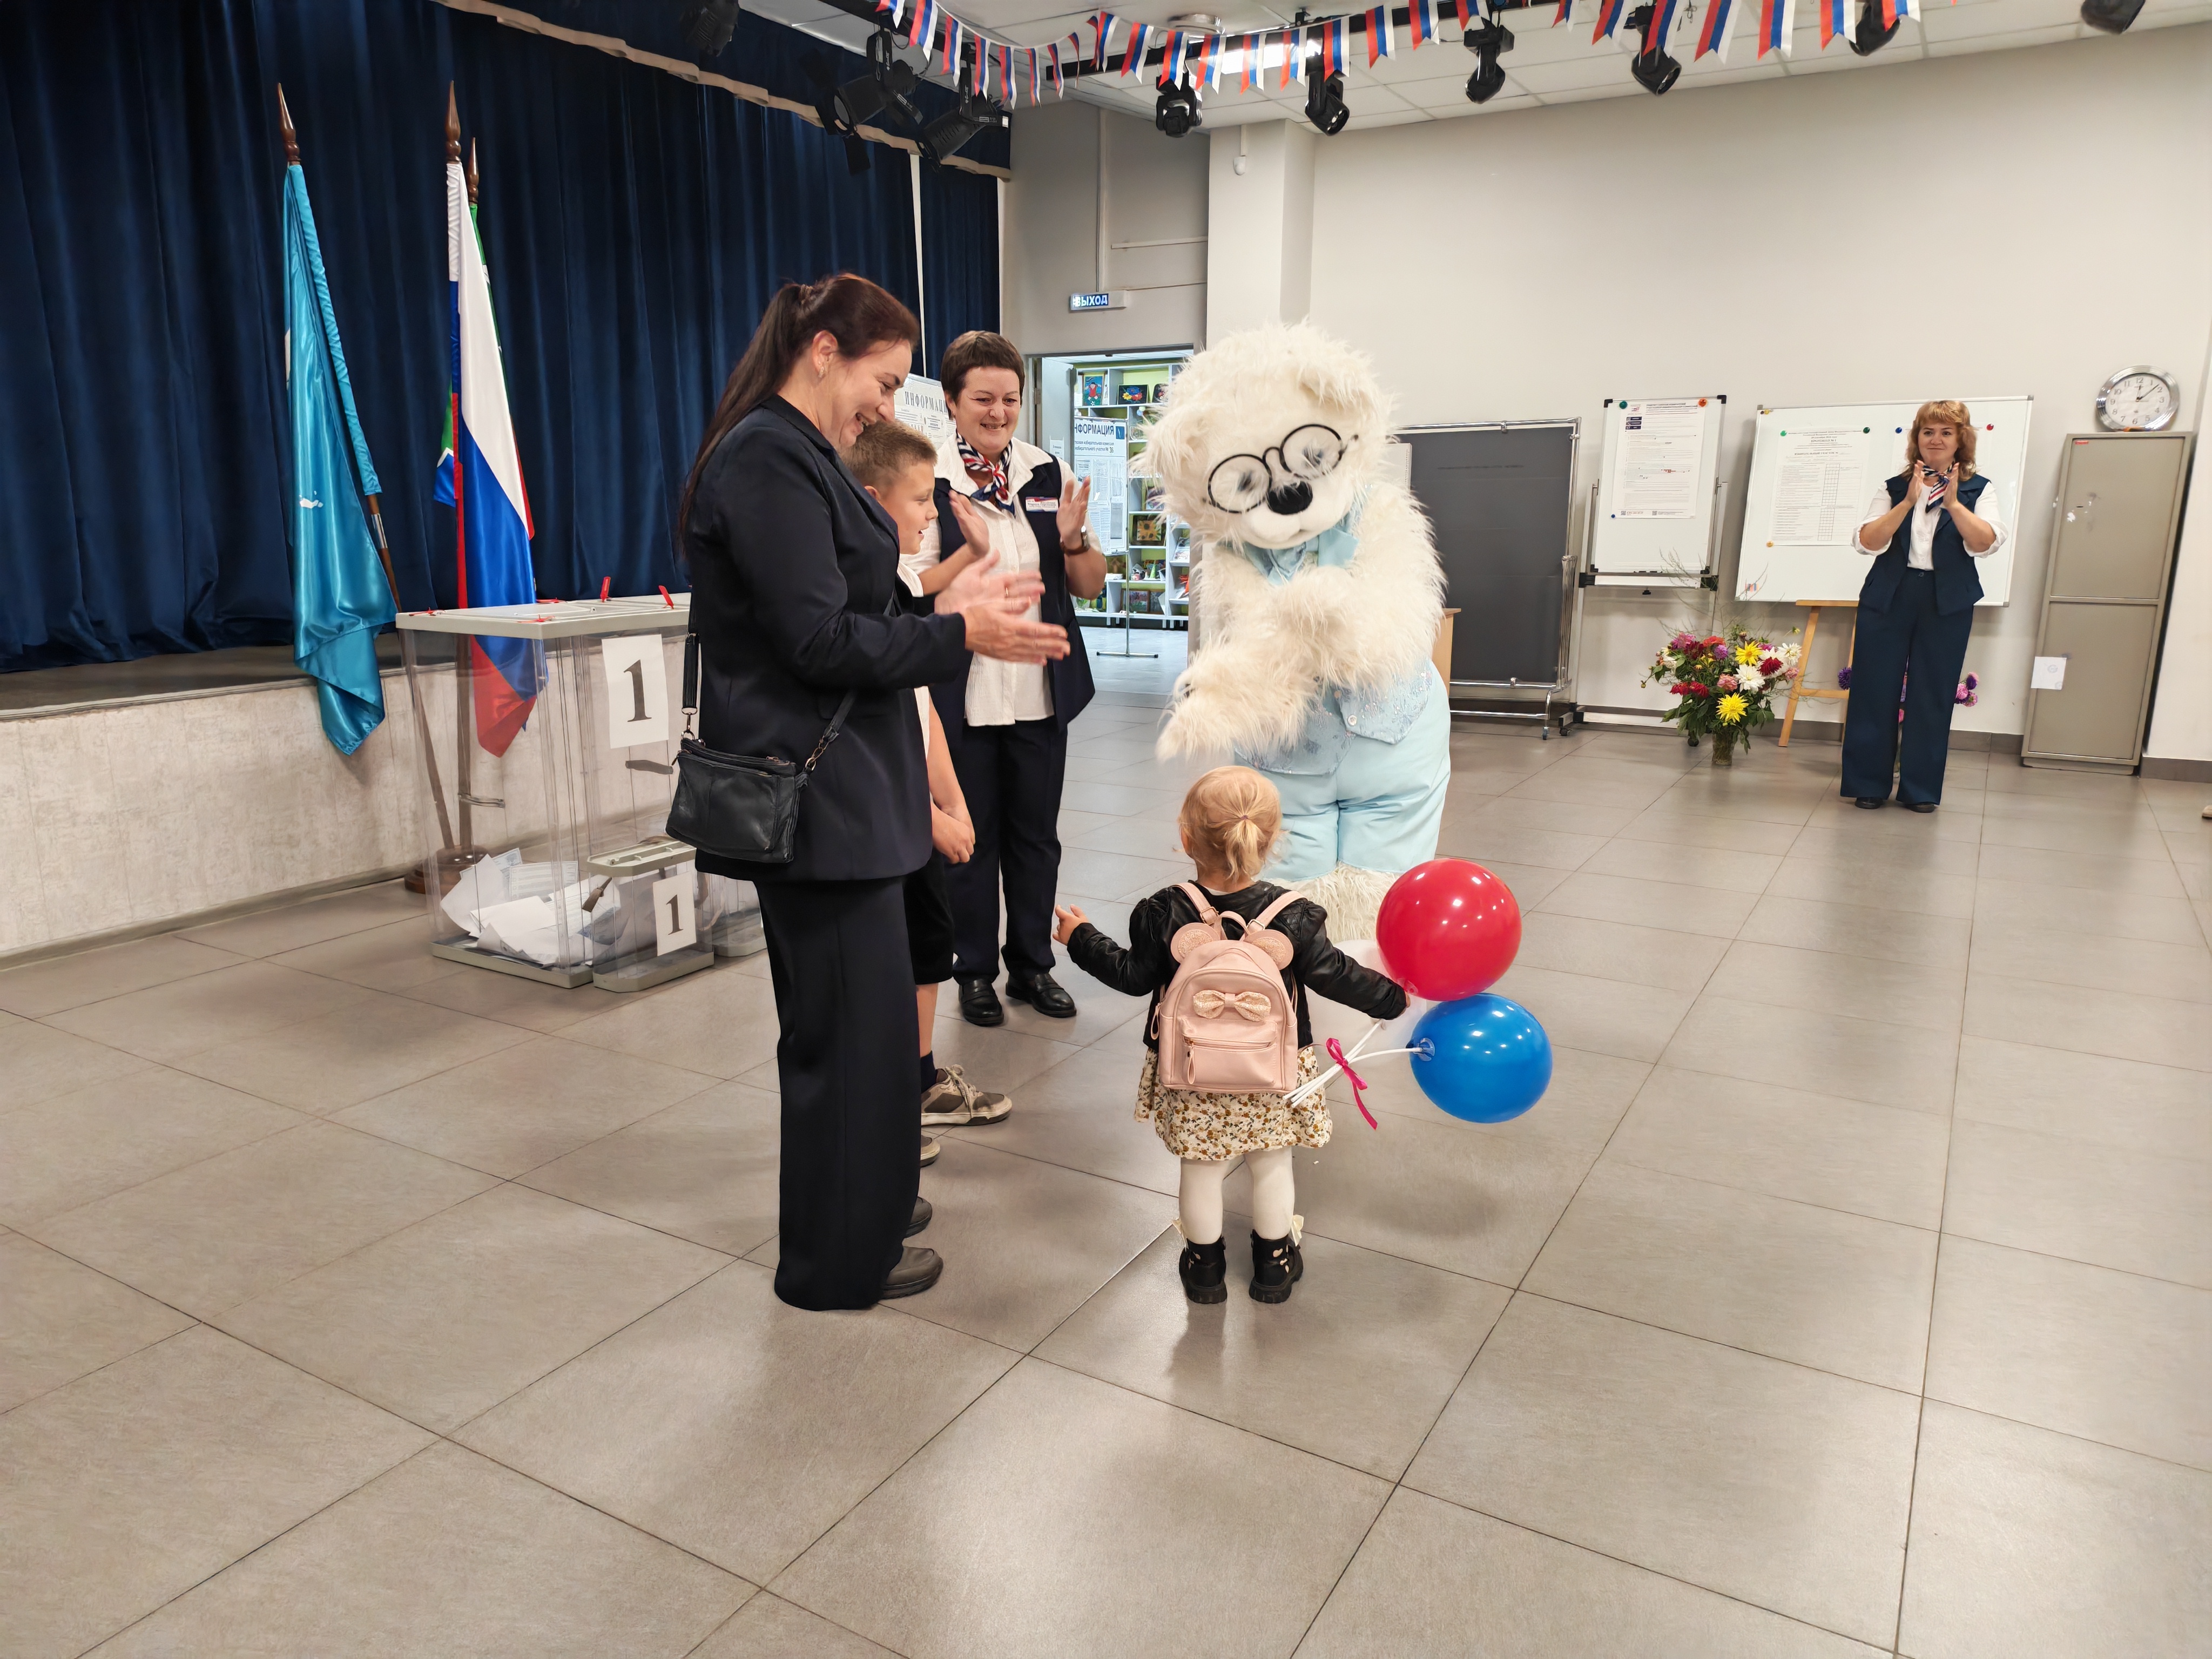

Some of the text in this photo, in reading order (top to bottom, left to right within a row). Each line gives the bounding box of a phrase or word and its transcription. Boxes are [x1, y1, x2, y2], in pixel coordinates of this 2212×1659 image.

[1075, 295, 1108, 307] ВЫХОД
[1074, 423, 1114, 436] НФОРМАЦИЯ
[623, 659, 652, 723] 1
[665, 894, 684, 935] 1
